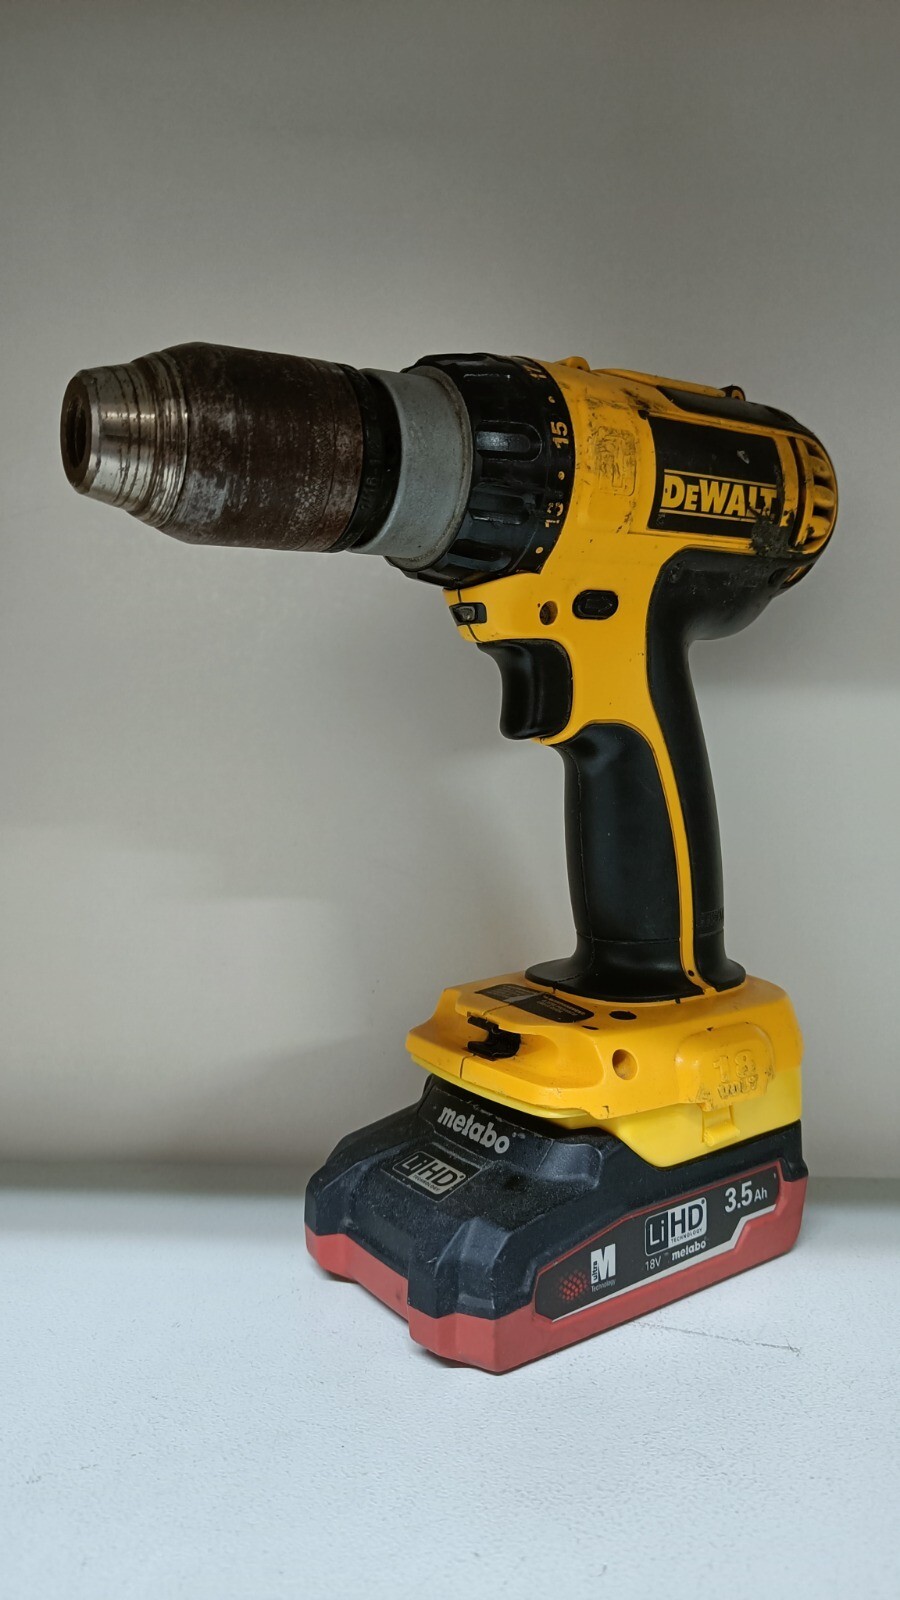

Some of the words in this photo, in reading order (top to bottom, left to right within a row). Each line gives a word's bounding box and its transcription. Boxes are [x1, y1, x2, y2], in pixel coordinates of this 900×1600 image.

[550, 421, 569, 449] 15
[660, 474, 778, 518] DEWALT
[545, 502, 564, 528] 13
[712, 1049, 756, 1083] 18
[437, 1106, 510, 1154] metabo
[402, 1155, 458, 1187] LiHD
[649, 1203, 704, 1246] LiHD
[671, 1228, 703, 1244] TECHNOLOGY
[645, 1256, 662, 1271] 18V
[672, 1239, 707, 1261] metabo
[591, 1280, 616, 1293] Technology
